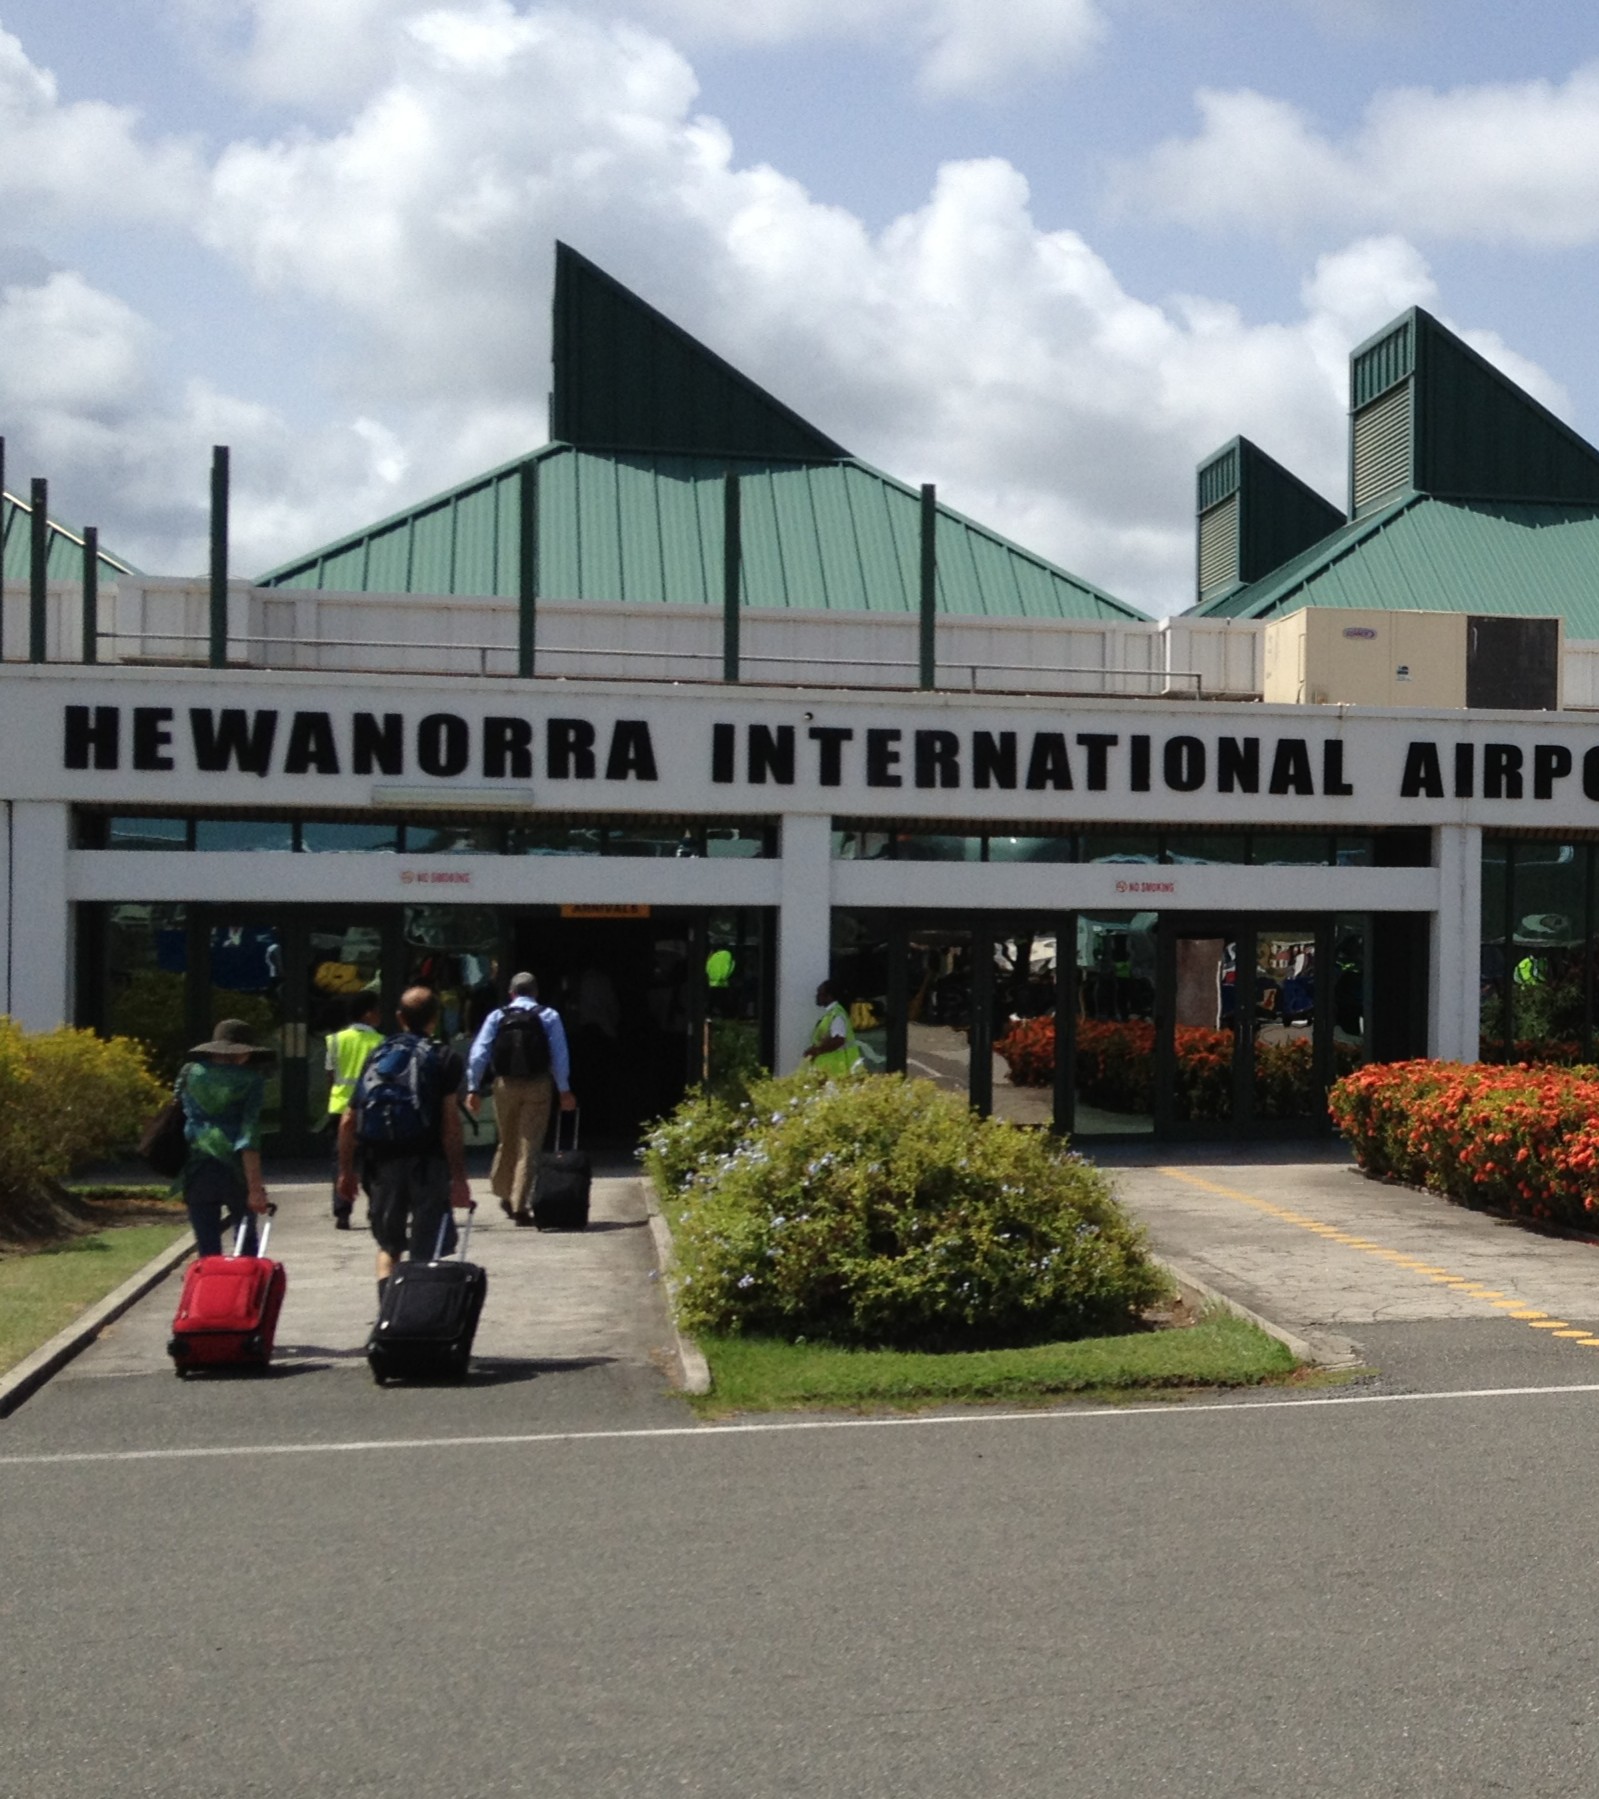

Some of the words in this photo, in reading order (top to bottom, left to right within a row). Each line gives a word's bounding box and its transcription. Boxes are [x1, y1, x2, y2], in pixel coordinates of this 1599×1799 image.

[63, 704, 659, 781] HEWANORRA
[711, 722, 1354, 797] INTERNATIONAL
[417, 872, 429, 883] NO
[1129, 882, 1140, 892] NO
[1141, 882, 1174, 893] SMOKING
